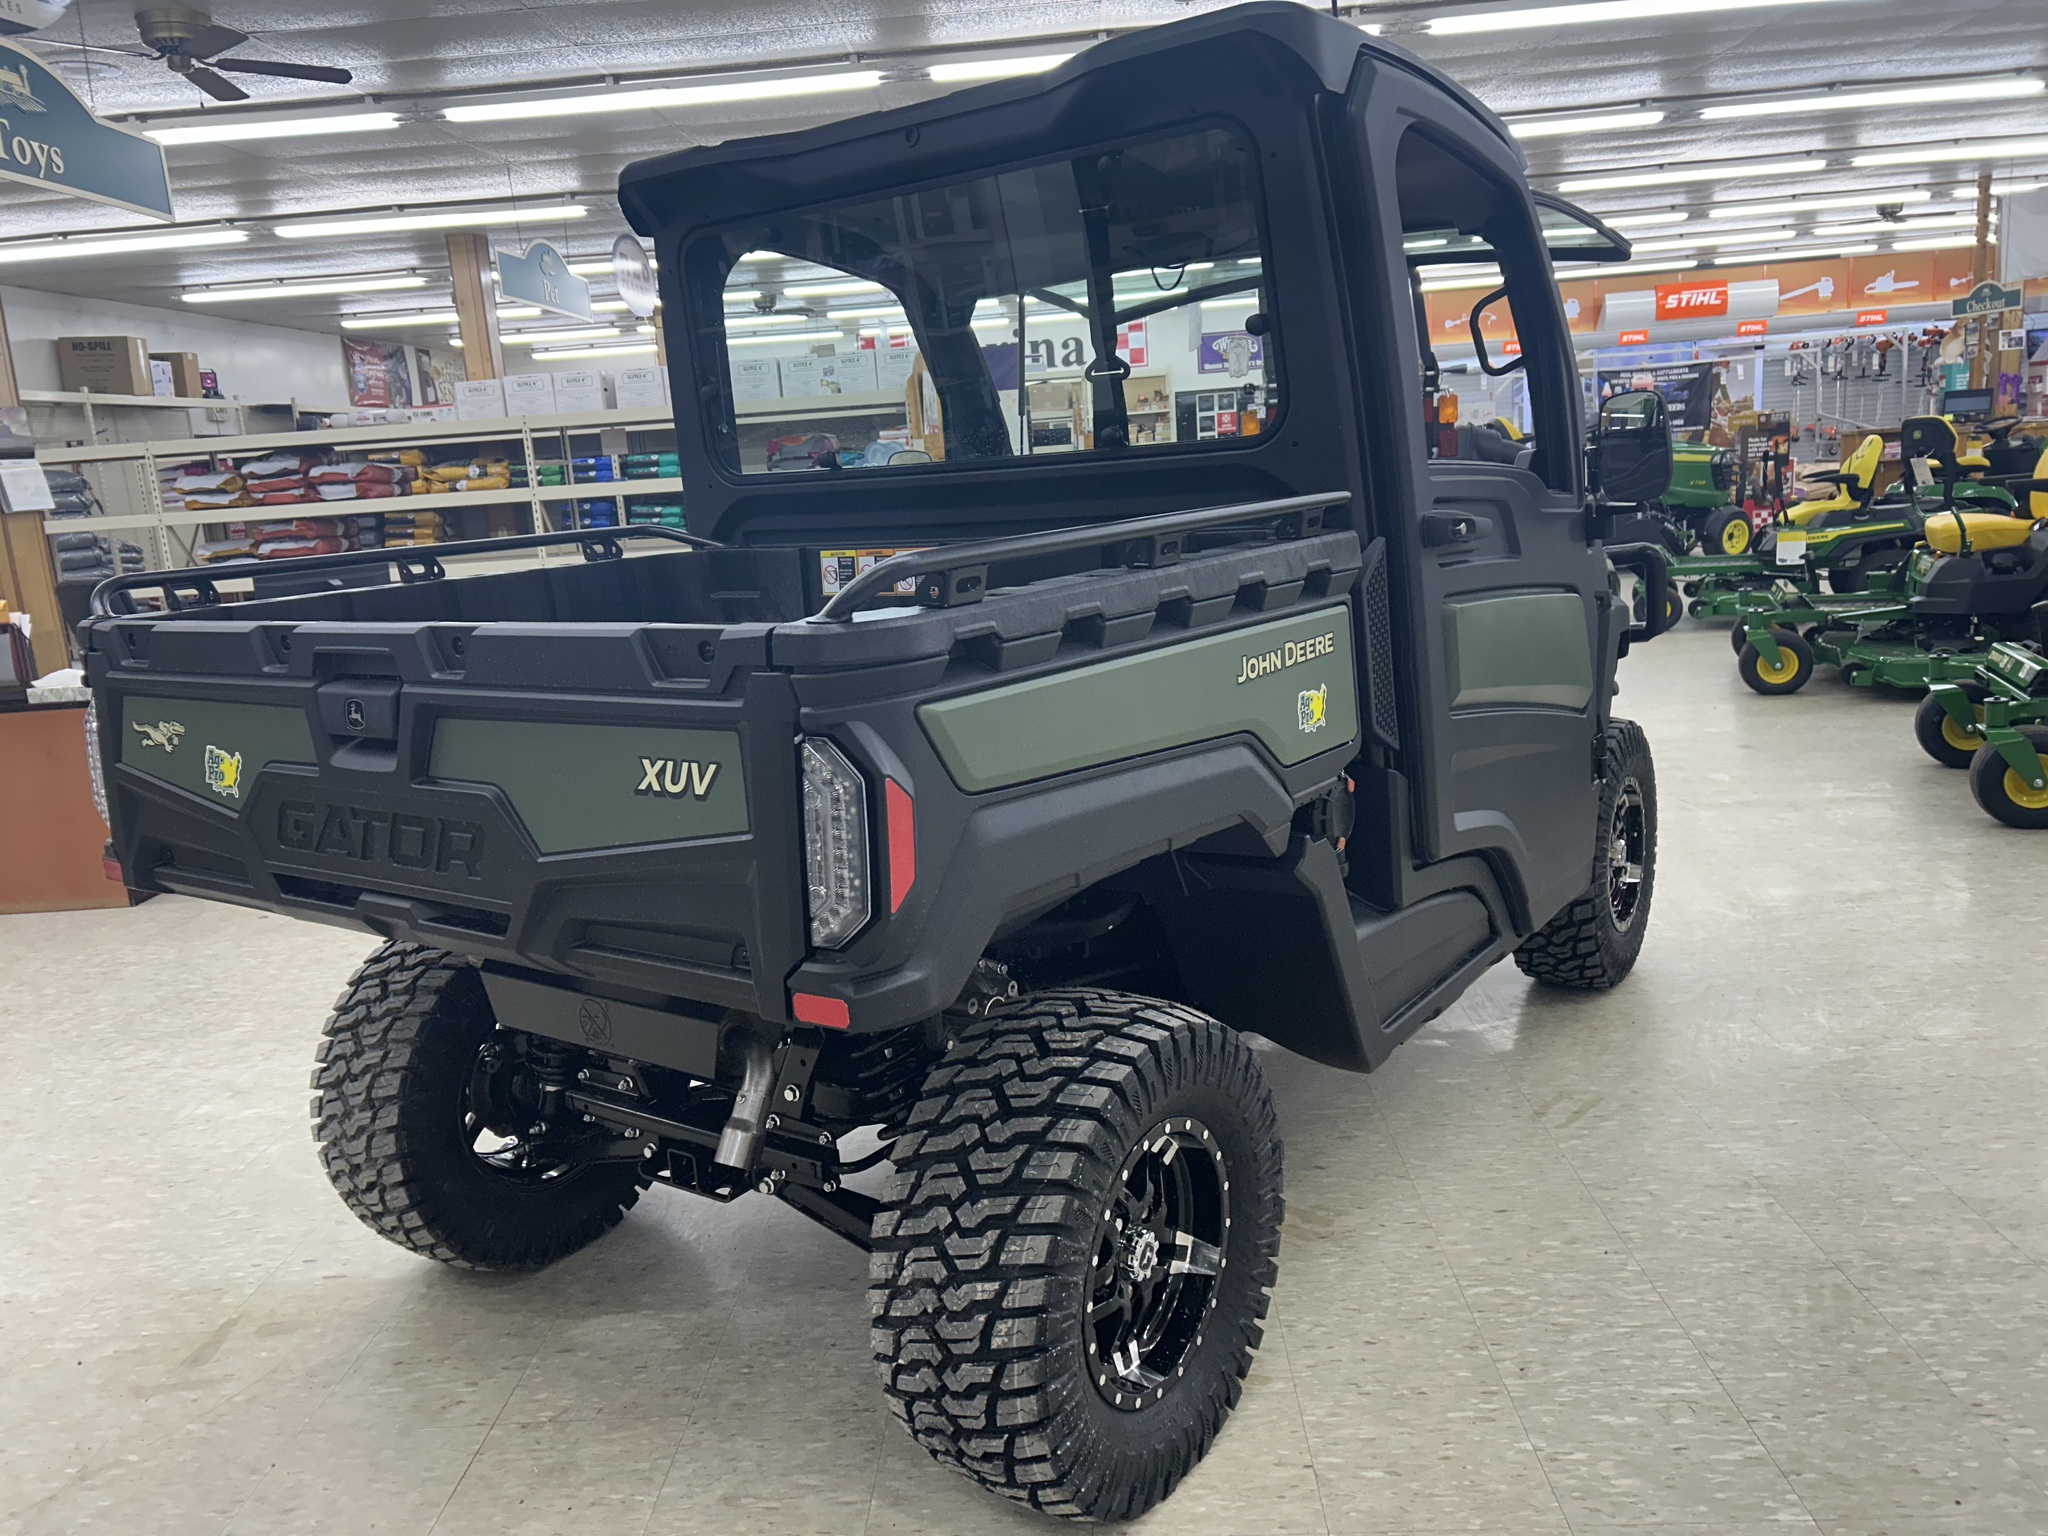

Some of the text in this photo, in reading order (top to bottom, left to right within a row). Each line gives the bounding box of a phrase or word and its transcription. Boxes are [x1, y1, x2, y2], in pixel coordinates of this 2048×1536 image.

[0, 118, 65, 179] Toys
[542, 279, 560, 304] Pet
[1665, 291, 1722, 309] STIHL
[1966, 298, 2006, 313] Checkout
[1859, 313, 1885, 322] STIHL
[1739, 323, 1765, 333] STIHL
[1621, 333, 1647, 343] STIHL
[1505, 343, 1521, 351] STI
[1237, 632, 1334, 685] JOHN DEERE
[1300, 696, 1314, 712] Ag-
[1300, 710, 1315, 726] Pro
[207, 749, 224, 769] Ag-
[207, 766, 225, 782] Pro
[636, 757, 720, 798] XUV
[277, 800, 486, 881] GATOR
